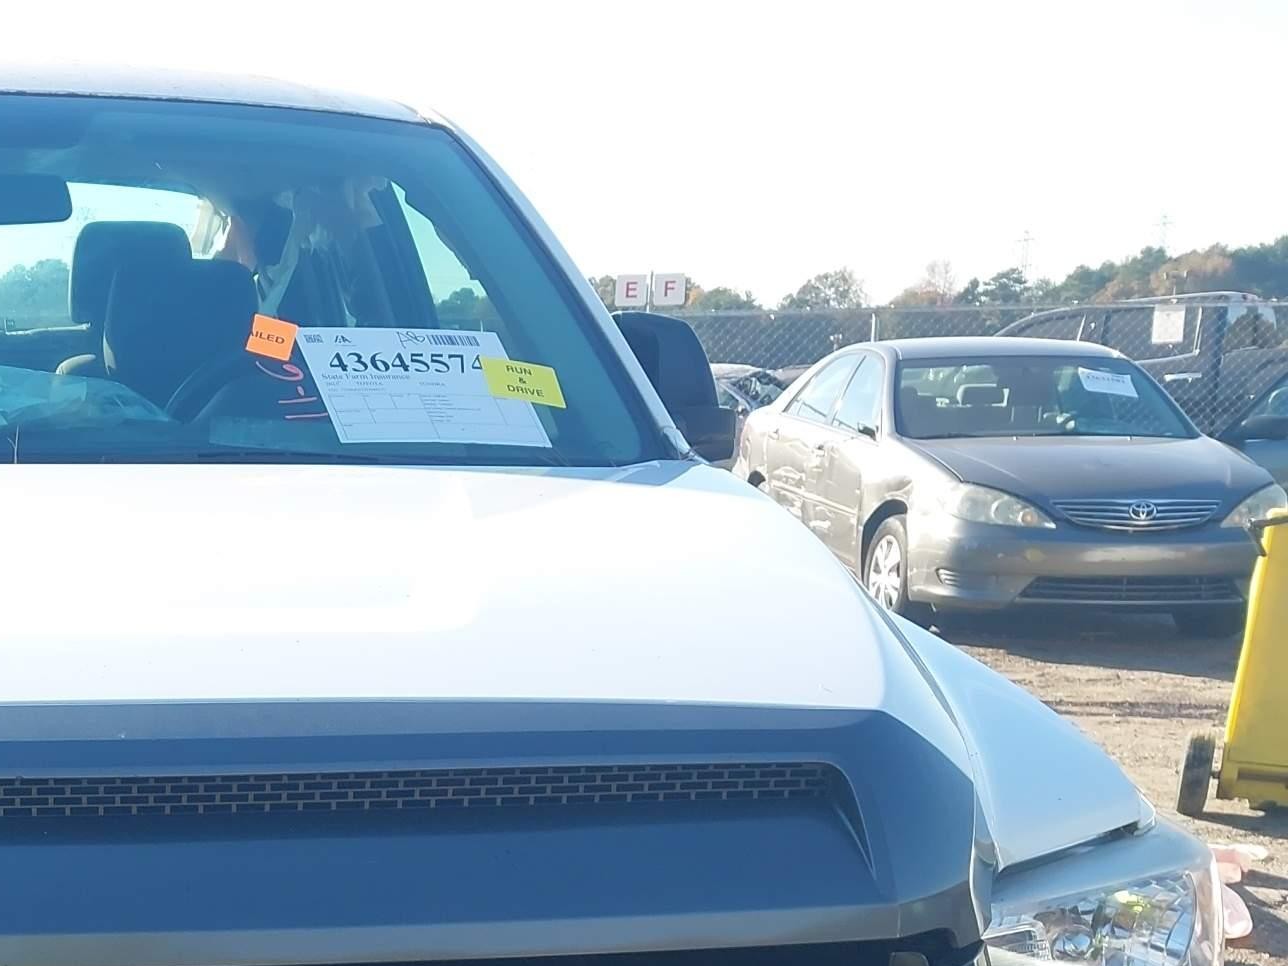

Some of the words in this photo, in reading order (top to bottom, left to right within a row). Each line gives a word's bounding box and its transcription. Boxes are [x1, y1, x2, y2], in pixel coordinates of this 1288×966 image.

[625, 281, 639, 299] E
[663, 280, 676, 297] F
[329, 351, 483, 374] 43645574
[321, 372, 343, 380] State
[370, 372, 410, 380] Insurance
[505, 365, 532, 376] RUN
[506, 384, 545, 398] DRIVE
